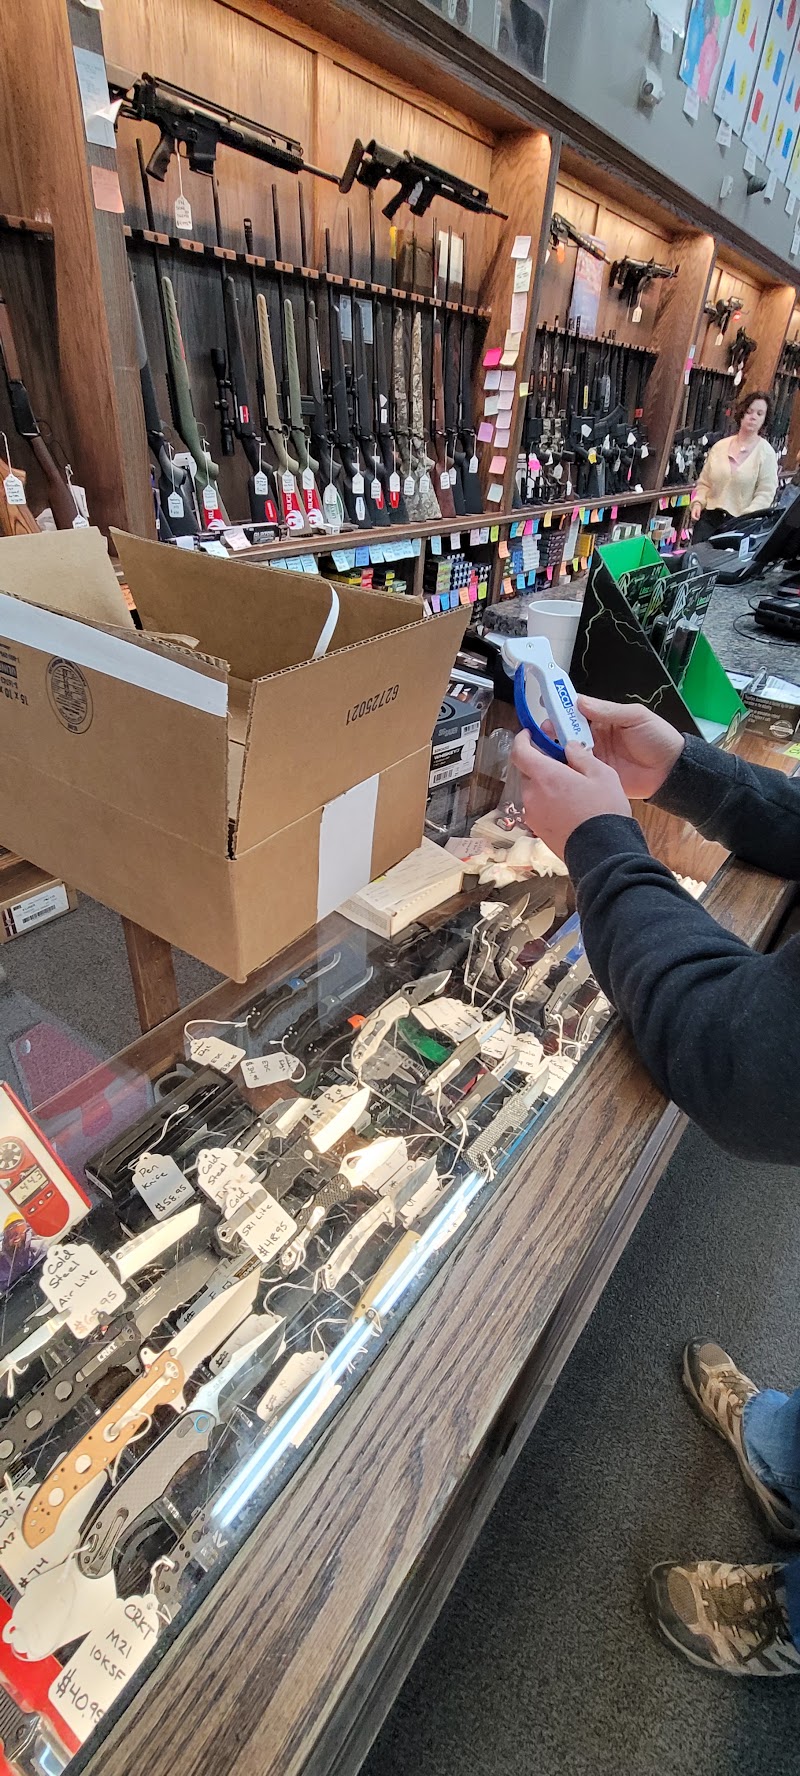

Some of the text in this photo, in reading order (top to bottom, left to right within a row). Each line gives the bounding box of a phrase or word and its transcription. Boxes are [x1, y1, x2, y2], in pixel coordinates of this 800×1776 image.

[346, 684, 400, 726] 62725021
[139, 1165, 159, 1177] Pen
[202, 1154, 221, 1175] Cold
[208, 1163, 228, 1185] Steel
[155, 1184, 187, 1212] $58.95
[229, 1187, 249, 1208] Cold
[255, 1204, 273, 1220] Lite
[258, 1221, 289, 1257] $48.95
[47, 1249, 75, 1275] Cold
[49, 1260, 80, 1289] Steel
[58, 1269, 98, 1308] Air Lite
[97, 1342, 118, 1363] CRKT
[124, 1603, 155, 1640] CRKT
[106, 1628, 132, 1659] M21
[89, 1644, 126, 1681] 10KSF
[55, 1668, 105, 1724] $40.95
